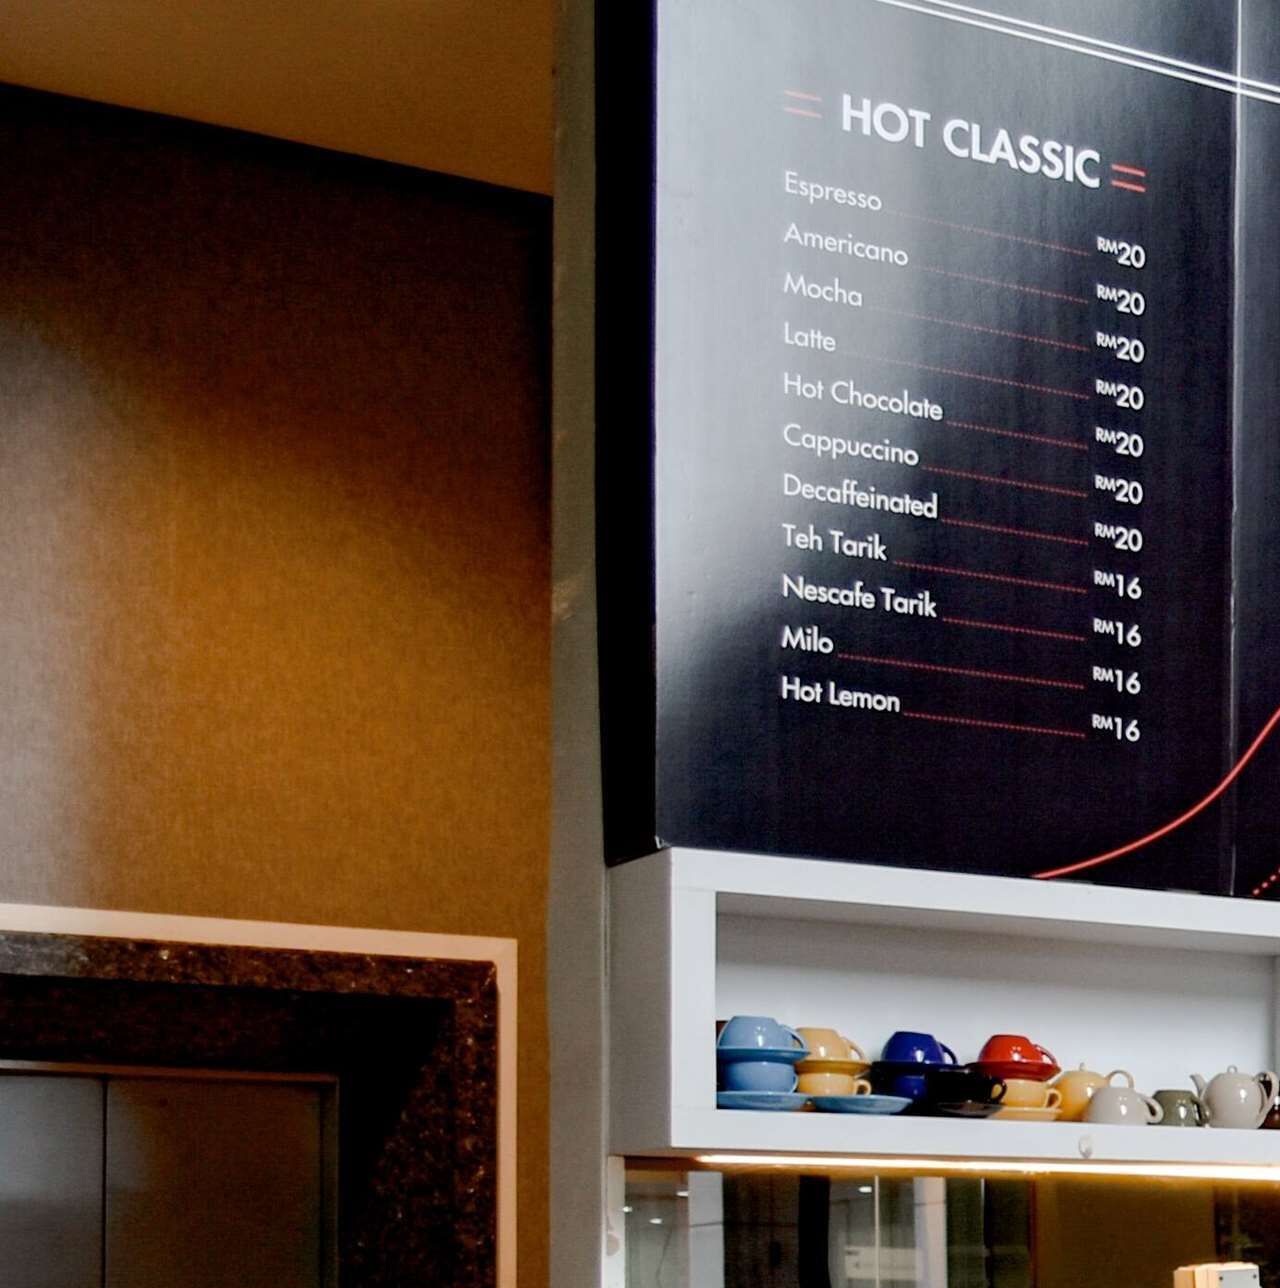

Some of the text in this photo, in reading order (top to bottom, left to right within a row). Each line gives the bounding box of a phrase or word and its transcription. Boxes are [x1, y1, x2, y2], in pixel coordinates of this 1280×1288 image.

[843, 94, 1099, 187] HOT CLASSIC
[785, 170, 881, 210] Espresso
[784, 223, 908, 265] Americano
[1097, 236, 1145, 268] RM20
[784, 272, 862, 306] Mocha
[1097, 284, 1144, 315] RM20
[784, 322, 835, 351] Latte
[1096, 332, 1144, 362] RM20
[784, 372, 942, 420] Hot Chocolate
[1096, 379, 1144, 409] RM20
[783, 424, 920, 466] Cappuccino
[1096, 427, 1143, 457] RM20
[784, 473, 938, 519] Decaffeinated
[1095, 475, 1143, 504] RM20
[782, 523, 886, 560] Teh Tarik
[1095, 523, 1142, 551] RM20
[782, 573, 936, 617] Nescafe Tarik
[1094, 570, 1141, 599] RM16
[782, 626, 833, 653] Milo
[1094, 618, 1141, 646] RM16
[782, 676, 900, 712] Hot Lemon
[1093, 666, 1140, 694] RM16
[1092, 714, 1140, 741] RM16
